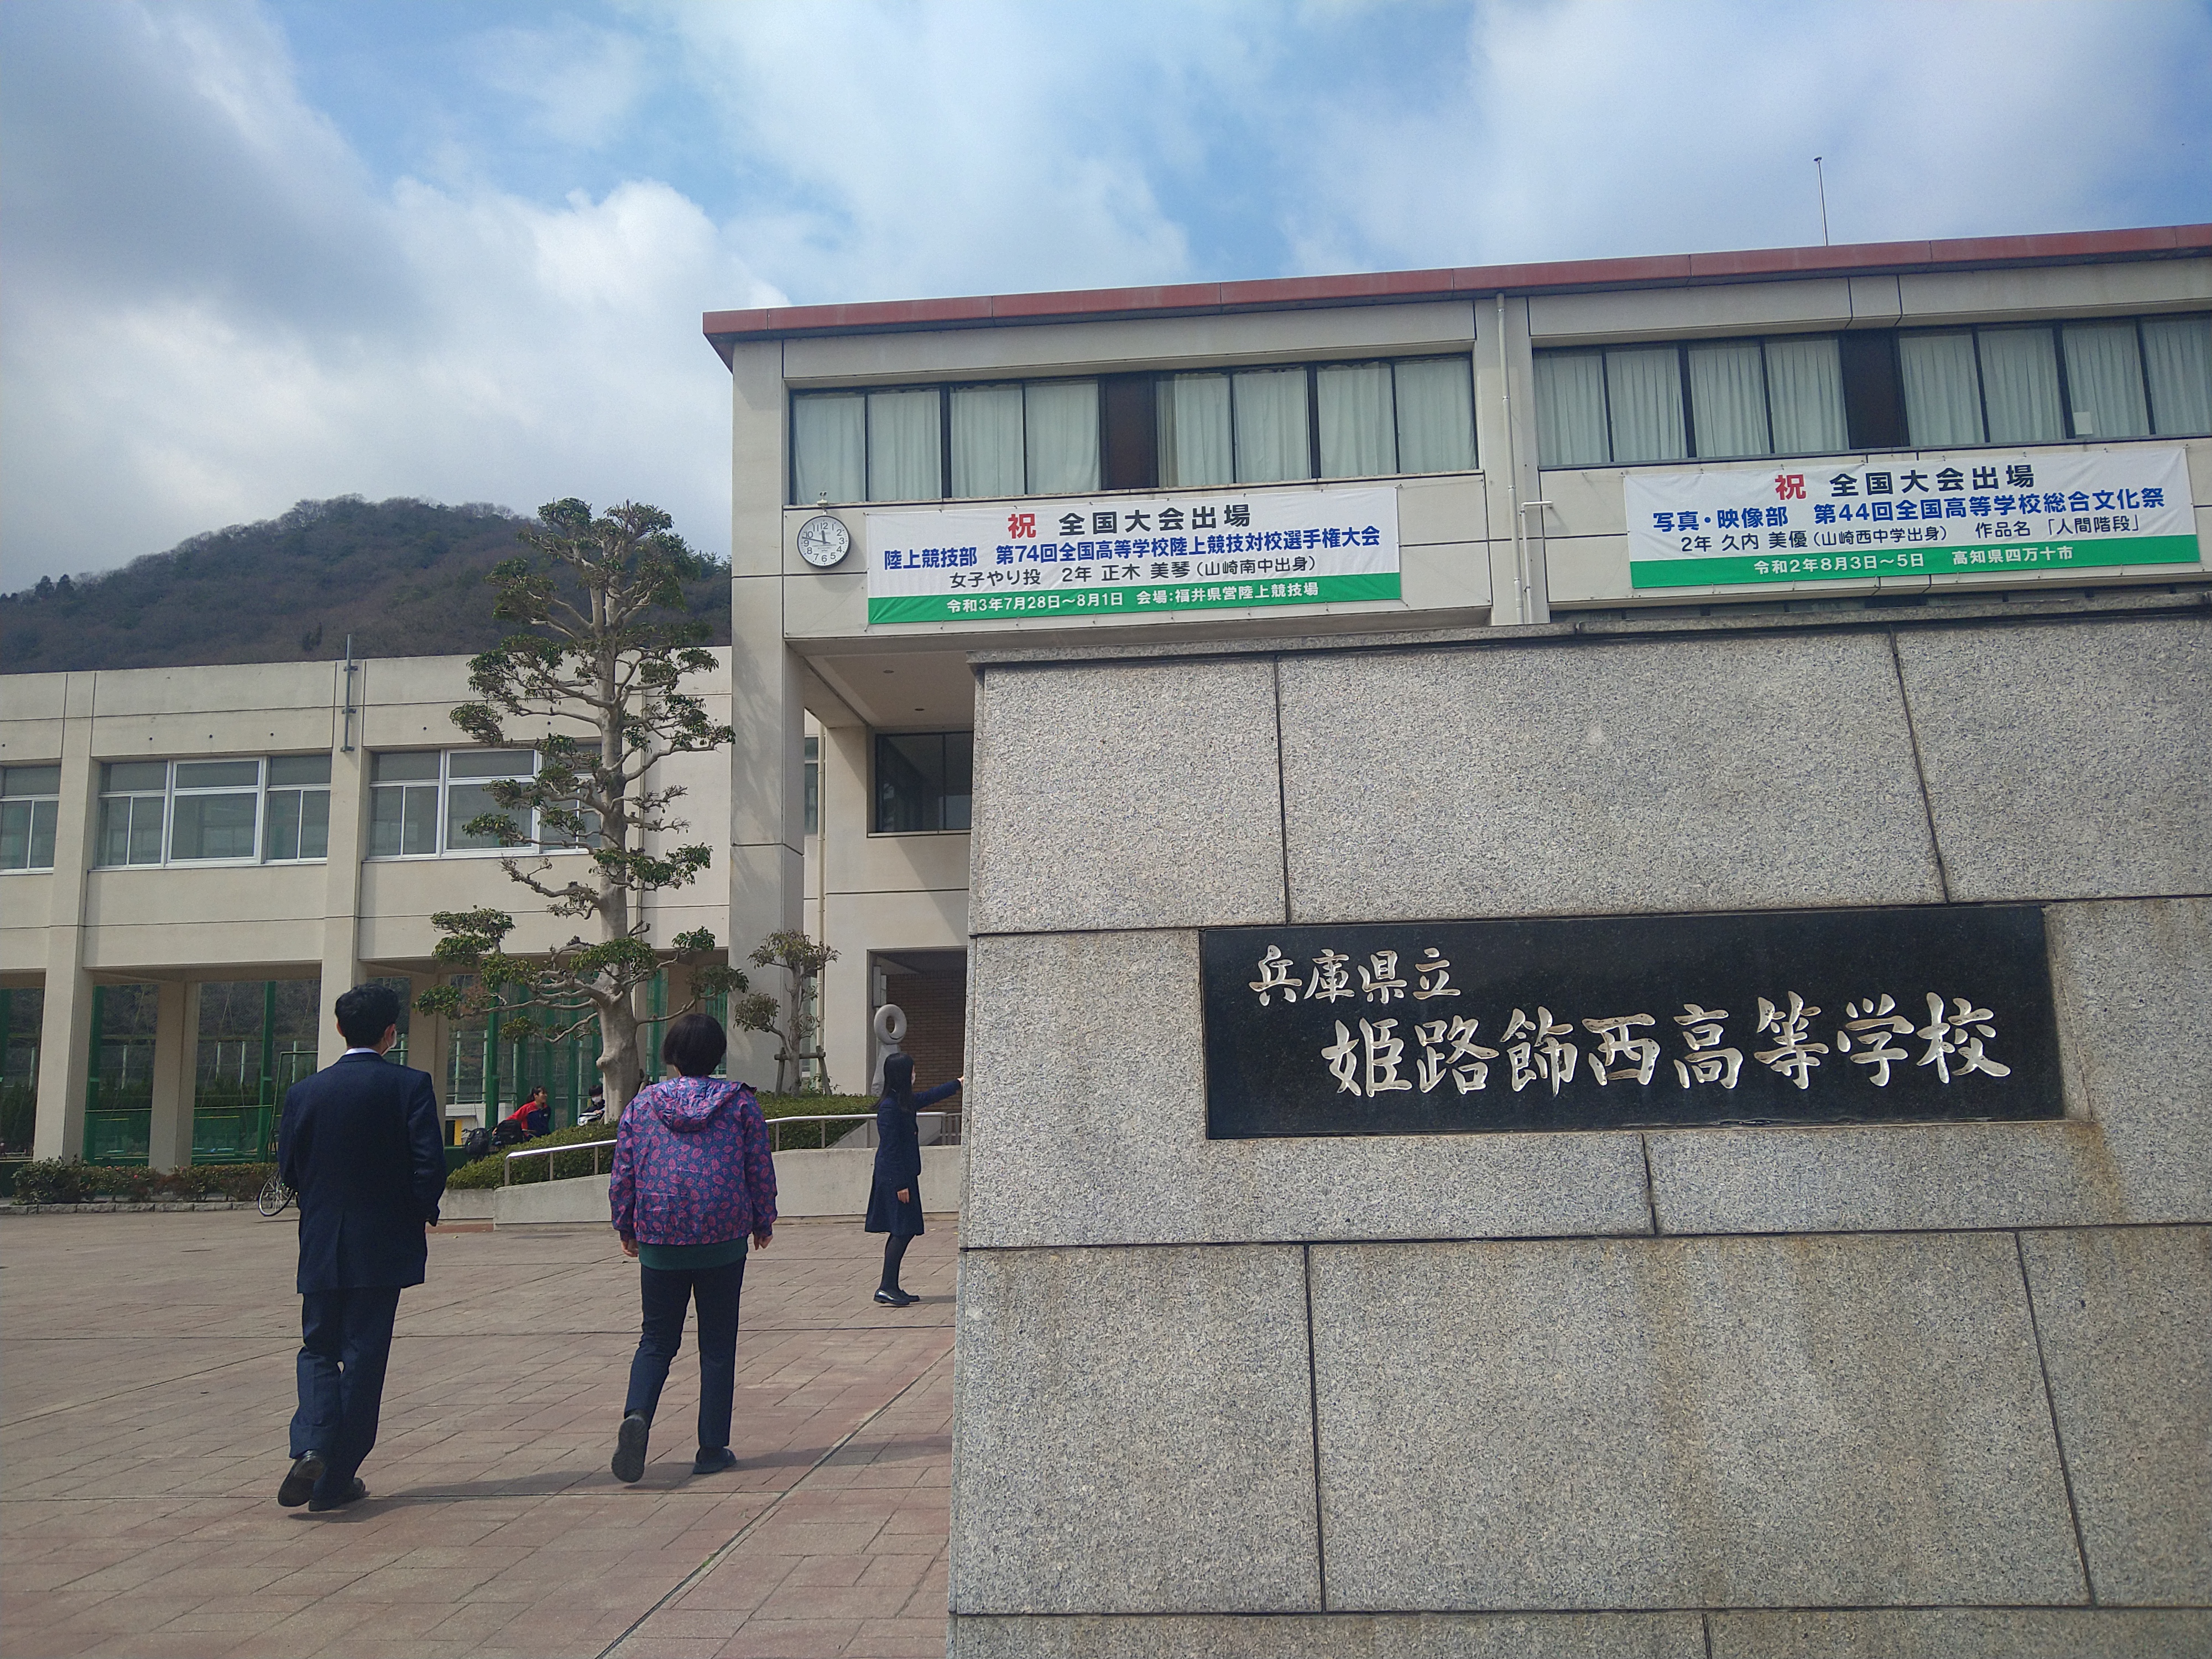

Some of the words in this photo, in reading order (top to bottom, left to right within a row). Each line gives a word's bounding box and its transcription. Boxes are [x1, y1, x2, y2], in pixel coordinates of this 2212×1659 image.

[1775, 474, 1807, 500] 祝
[1829, 465, 2035, 497] 全国大会出場
[1008, 513, 1037, 539] 祝
[1058, 504, 1251, 536] 全国大会出場
[1652, 505, 1789, 533] 写真・映像部
[1814, 487, 2166, 525] 第44回全国高等学校総合文化祭
[884, 546, 978, 570] 陸上競技部
[995, 525, 1380, 566] 第74回全国高等学校陸上競技対校選手権大会
[1952, 545, 2074, 566] 高知県四万十市
[950, 568, 1041, 588] 女子やり投
[1249, 944, 1461, 1006] 兵庫県立
[1321, 991, 2012, 1098] 姫路飾西高等学校
